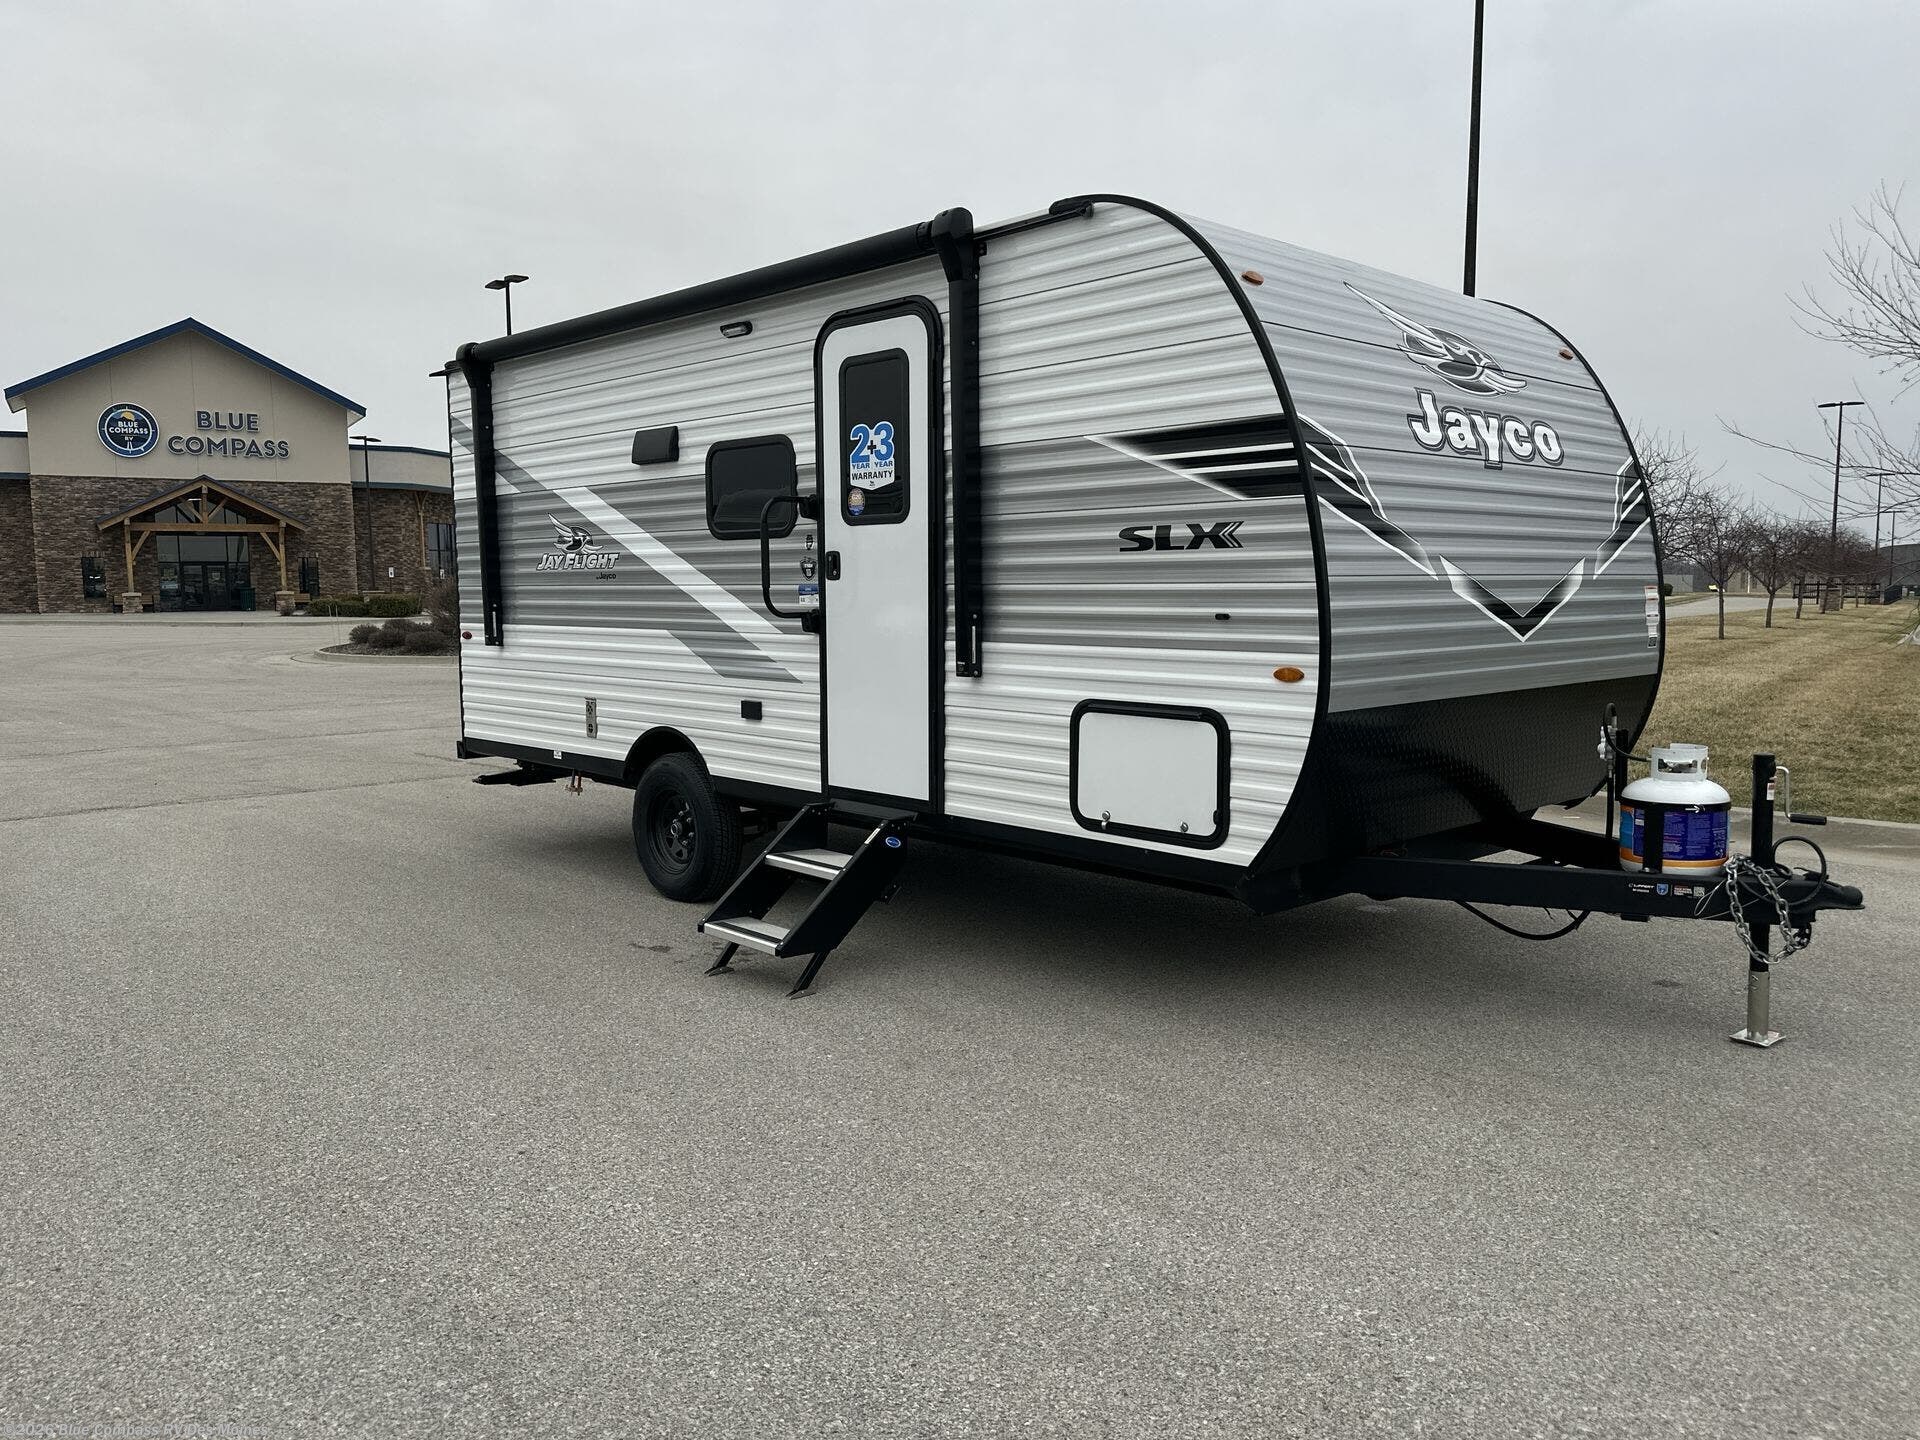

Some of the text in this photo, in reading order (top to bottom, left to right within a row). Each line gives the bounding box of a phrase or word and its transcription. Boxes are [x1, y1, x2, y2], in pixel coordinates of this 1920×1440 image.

[109, 427, 149, 435] COMPASS
[196, 410, 259, 432] BLUE
[1407, 387, 1565, 470] Jayco
[167, 435, 290, 459] COMPASS
[852, 460, 893, 470] YEAR YEAR
[851, 470, 894, 481] WARRANTY
[1119, 521, 1243, 552] SLX
[536, 552, 620, 571] JAY FLIGHT
